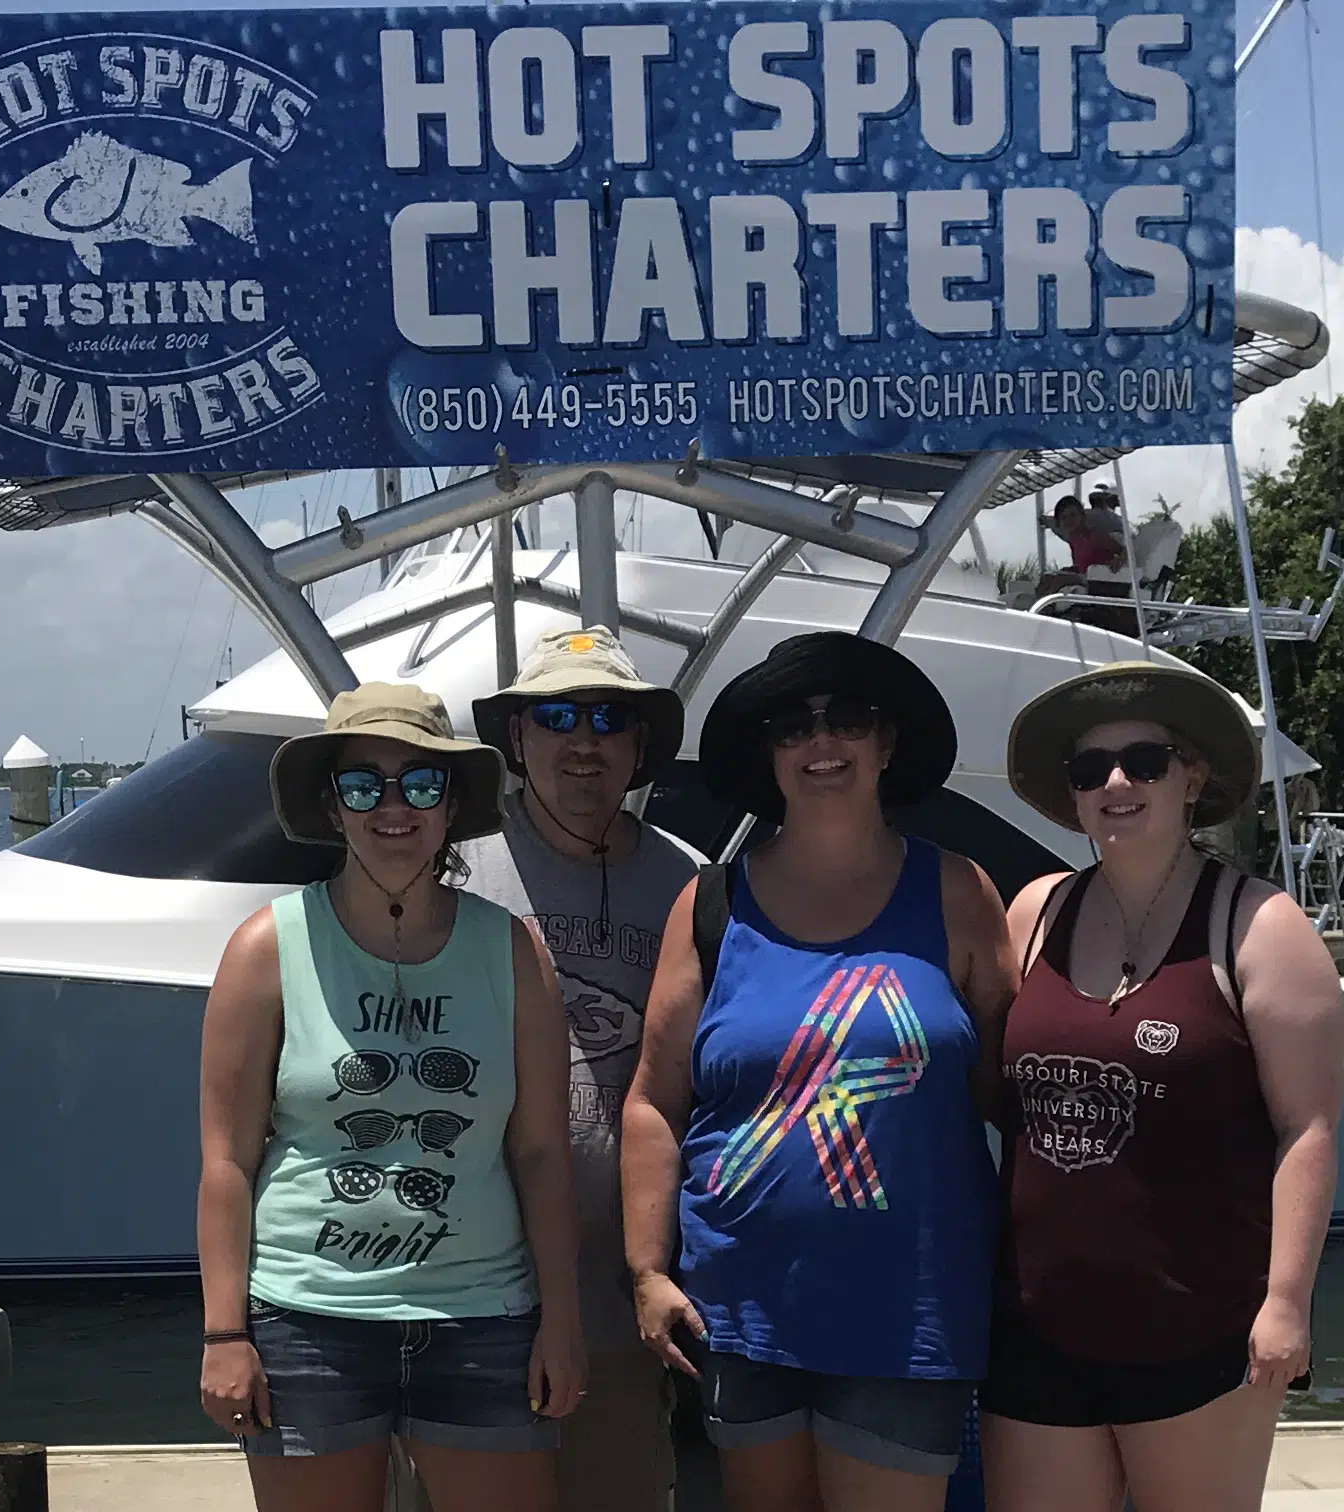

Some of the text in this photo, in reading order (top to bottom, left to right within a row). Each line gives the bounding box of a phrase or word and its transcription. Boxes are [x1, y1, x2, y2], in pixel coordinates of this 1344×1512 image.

[101, 46, 312, 153] SPOTS
[379, 13, 1196, 173] HOT SPOTS
[389, 184, 1196, 352] CHARTERS
[0, 279, 266, 328] FISHING
[67, 333, 209, 355] established 2004
[728, 367, 1195, 424] HOTSPOTSCHARTERS.COM
[353, 991, 454, 1036] SHINE
[1098, 1073, 1167, 1099] STATE
[1022, 1098, 1133, 1123] UNIVERSITY
[1043, 1133, 1105, 1154] BEARS
[314, 1219, 461, 1267] Bright
